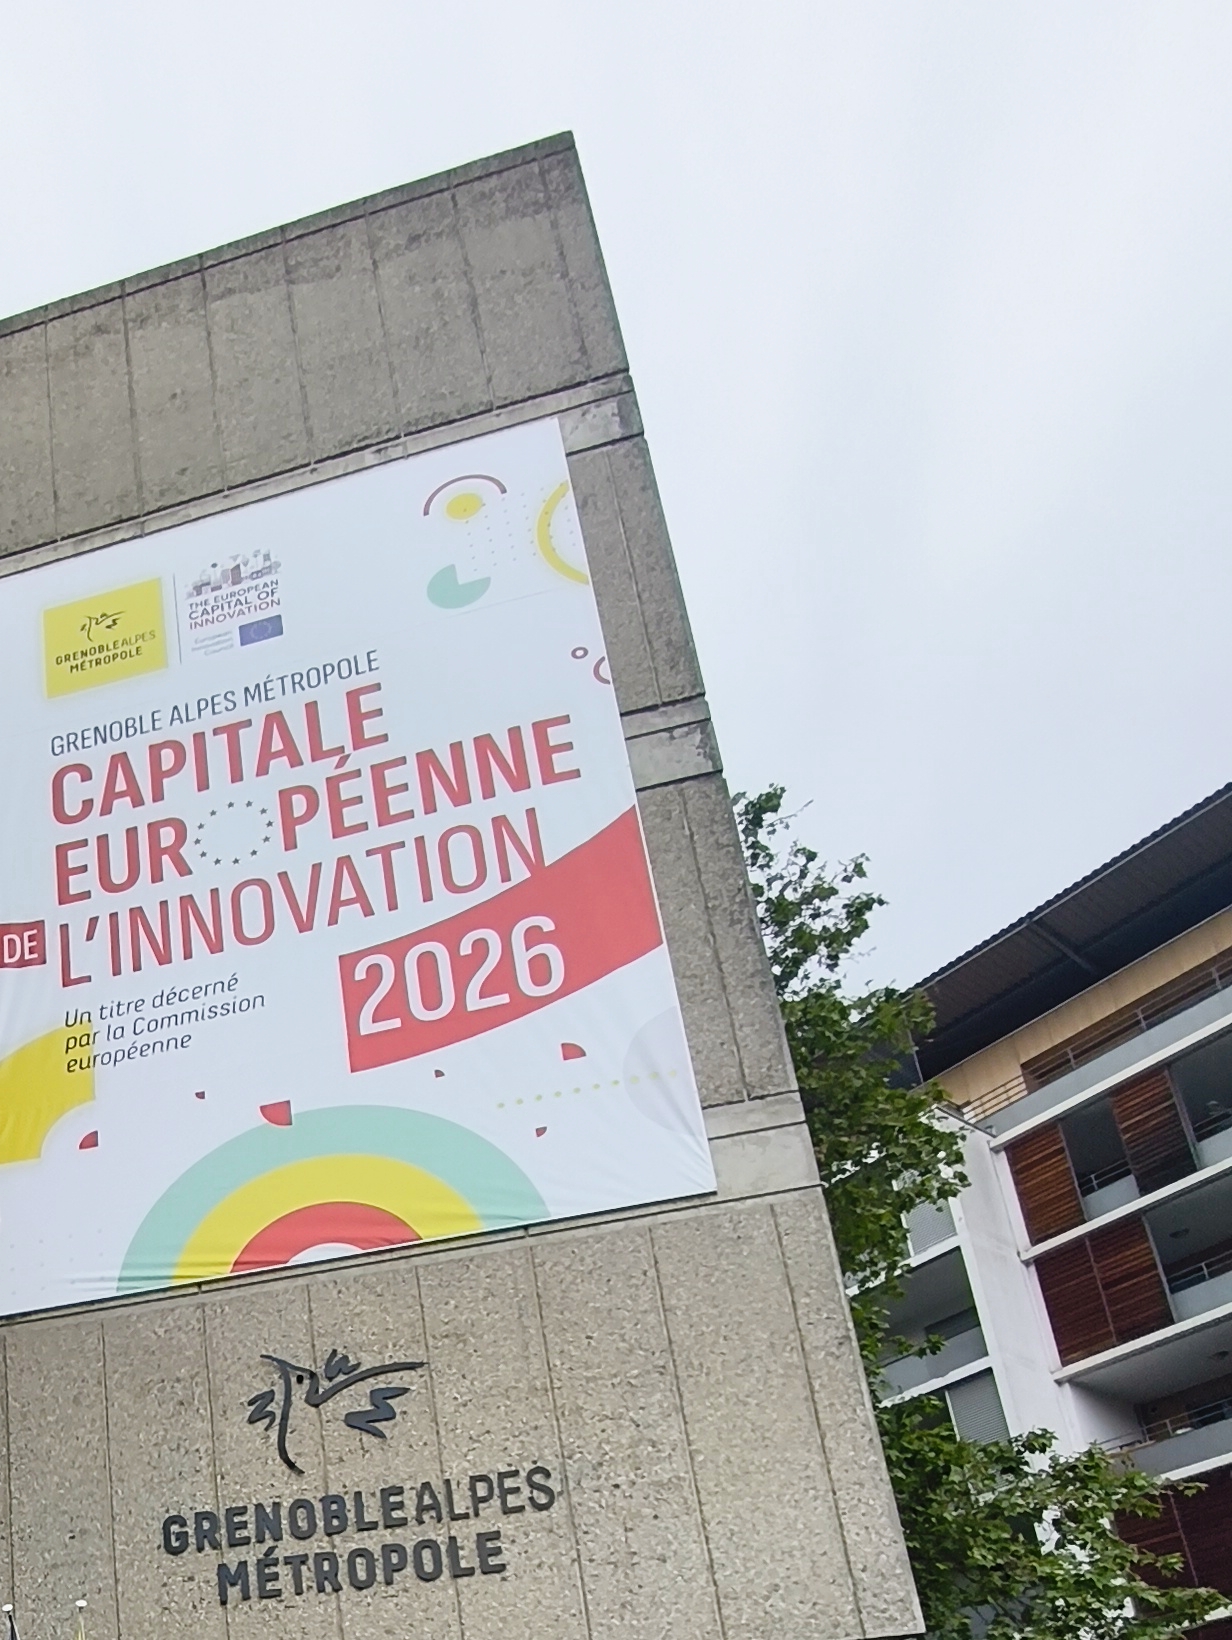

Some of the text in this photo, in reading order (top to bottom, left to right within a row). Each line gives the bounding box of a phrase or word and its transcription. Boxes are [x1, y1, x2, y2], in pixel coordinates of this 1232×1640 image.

[188, 587, 279, 620] CAPITAL OF
[189, 579, 279, 610] THE EUROPEAN
[189, 598, 281, 630] INNOVATION
[69, 646, 143, 674] MÉTROPOLE
[51, 649, 381, 757] GRENOBLE ALPES MÉTROPOLE
[50, 682, 390, 825] CAPITALE
[2, 806, 547, 988] DE L'INNOVATION
[64, 972, 240, 1028] Un titre décerné
[352, 914, 566, 1037] 2026
[64, 993, 266, 1054] par la Commission
[66, 1033, 193, 1074] européenne
[216, 1530, 507, 1606] MÉTROPOLE
